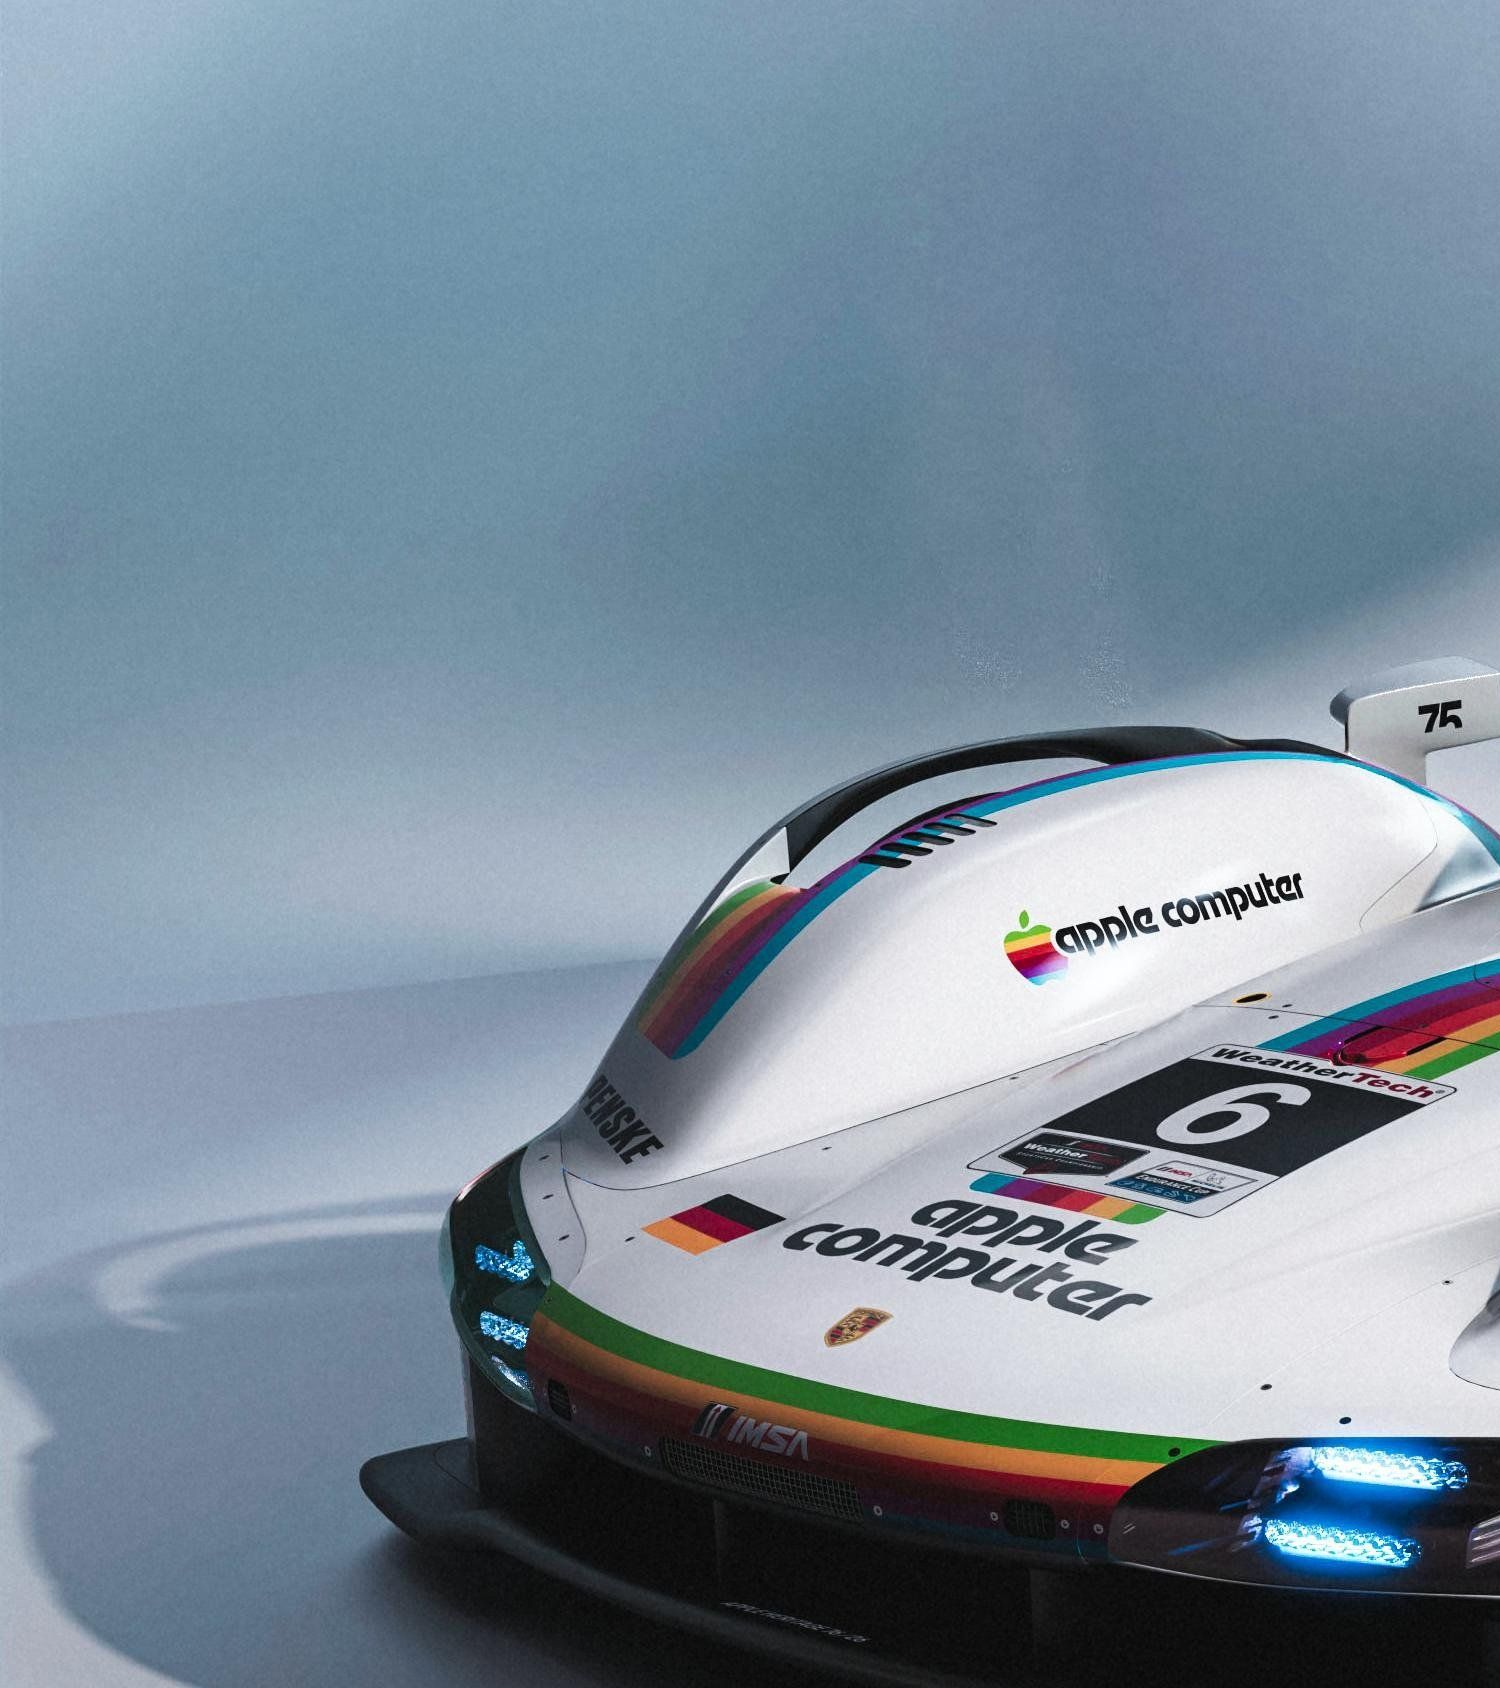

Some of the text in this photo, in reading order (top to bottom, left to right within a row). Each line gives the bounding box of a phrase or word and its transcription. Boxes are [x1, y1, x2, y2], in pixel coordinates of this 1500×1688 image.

[1418, 700, 1463, 733] 75
[1055, 872, 1304, 956] apple computer
[1213, 1046, 1434, 1099] WeatherTech
[583, 1075, 664, 1165] PENSKE
[1156, 1082, 1312, 1145] 6
[911, 1199, 1140, 1267] apple
[782, 1222, 1154, 1323] computer
[726, 1414, 809, 1462] IMSA
